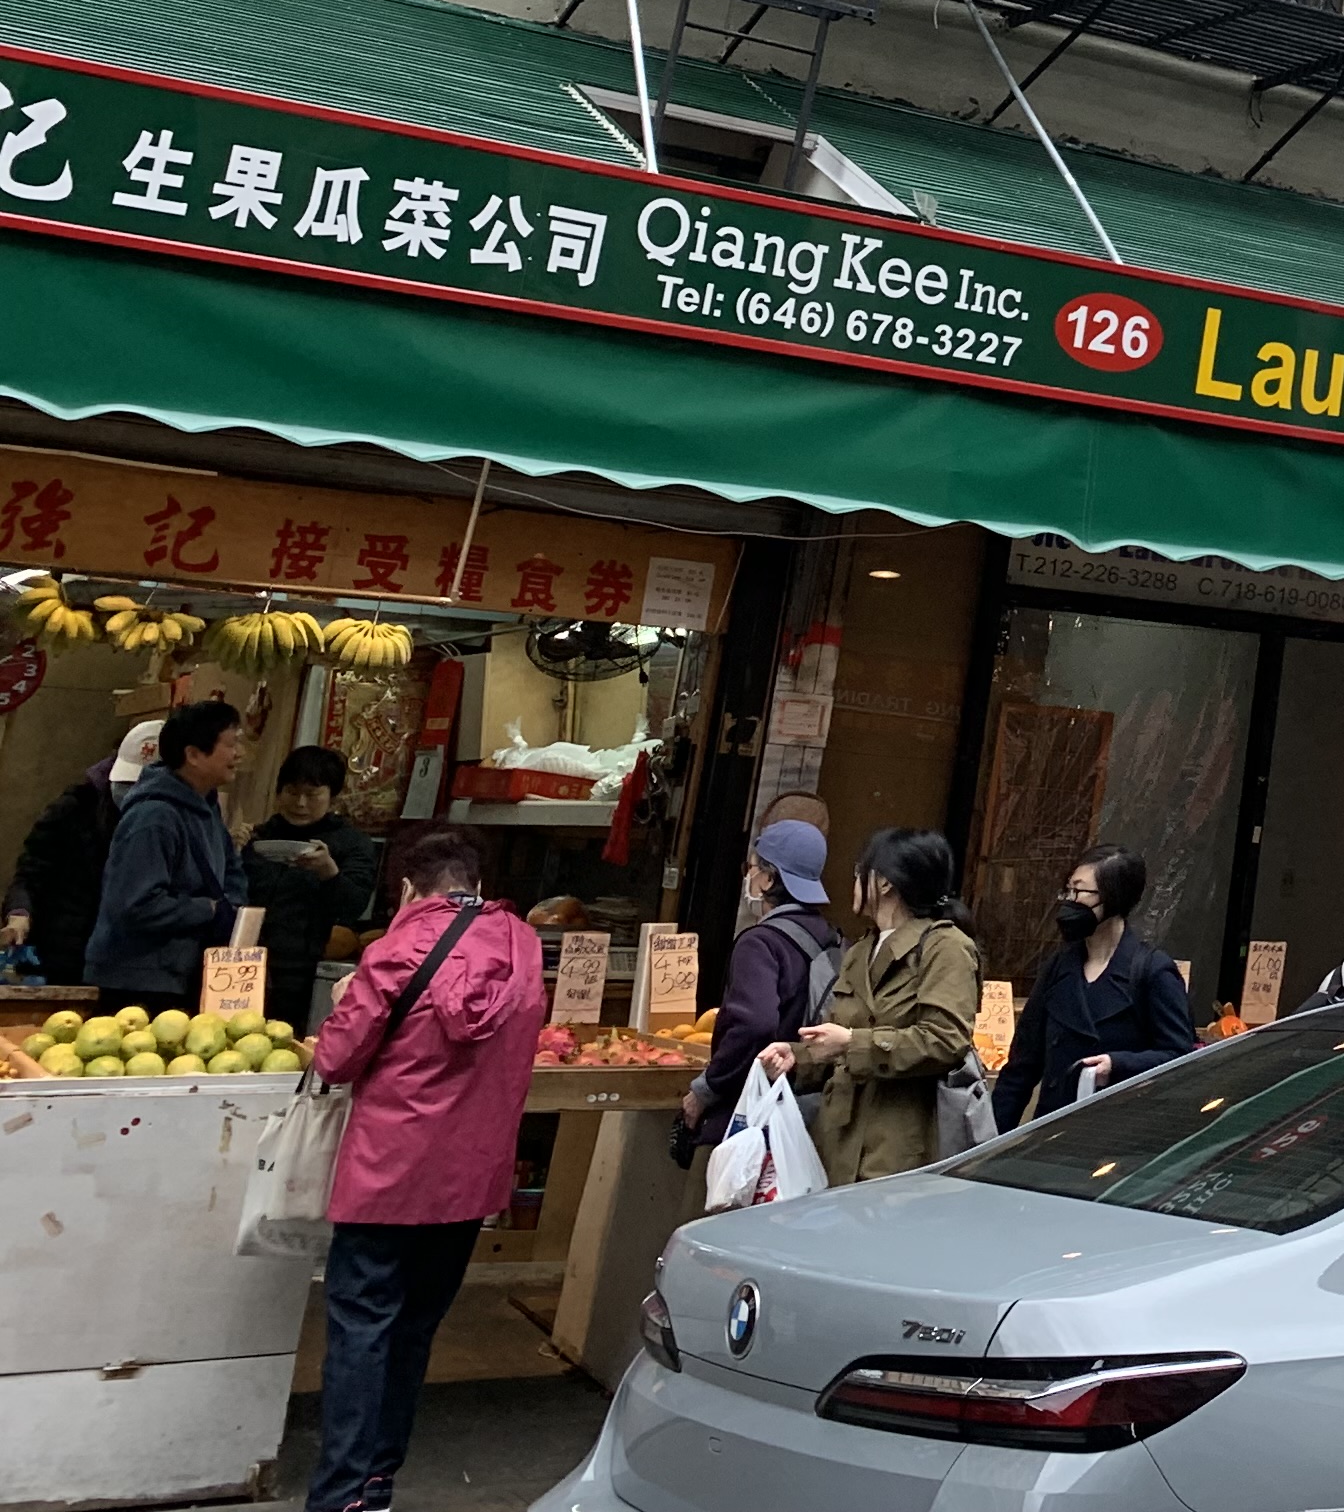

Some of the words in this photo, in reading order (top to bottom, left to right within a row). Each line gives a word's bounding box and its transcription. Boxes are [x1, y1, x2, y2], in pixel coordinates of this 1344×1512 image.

[112, 128, 609, 287] 生果瓜菜公司
[636, 197, 830, 299] Qiang
[832, 232, 948, 307] Kee
[953, 267, 1031, 323] Inc.
[656, 274, 724, 320] Tel:
[734, 288, 836, 340] (646)
[845, 308, 1024, 369] 678-3227
[1066, 306, 1151, 360] 126
[269, 518, 633, 618] 接受糧食券
[1016, 553, 1178, 592] T.212-226-3288
